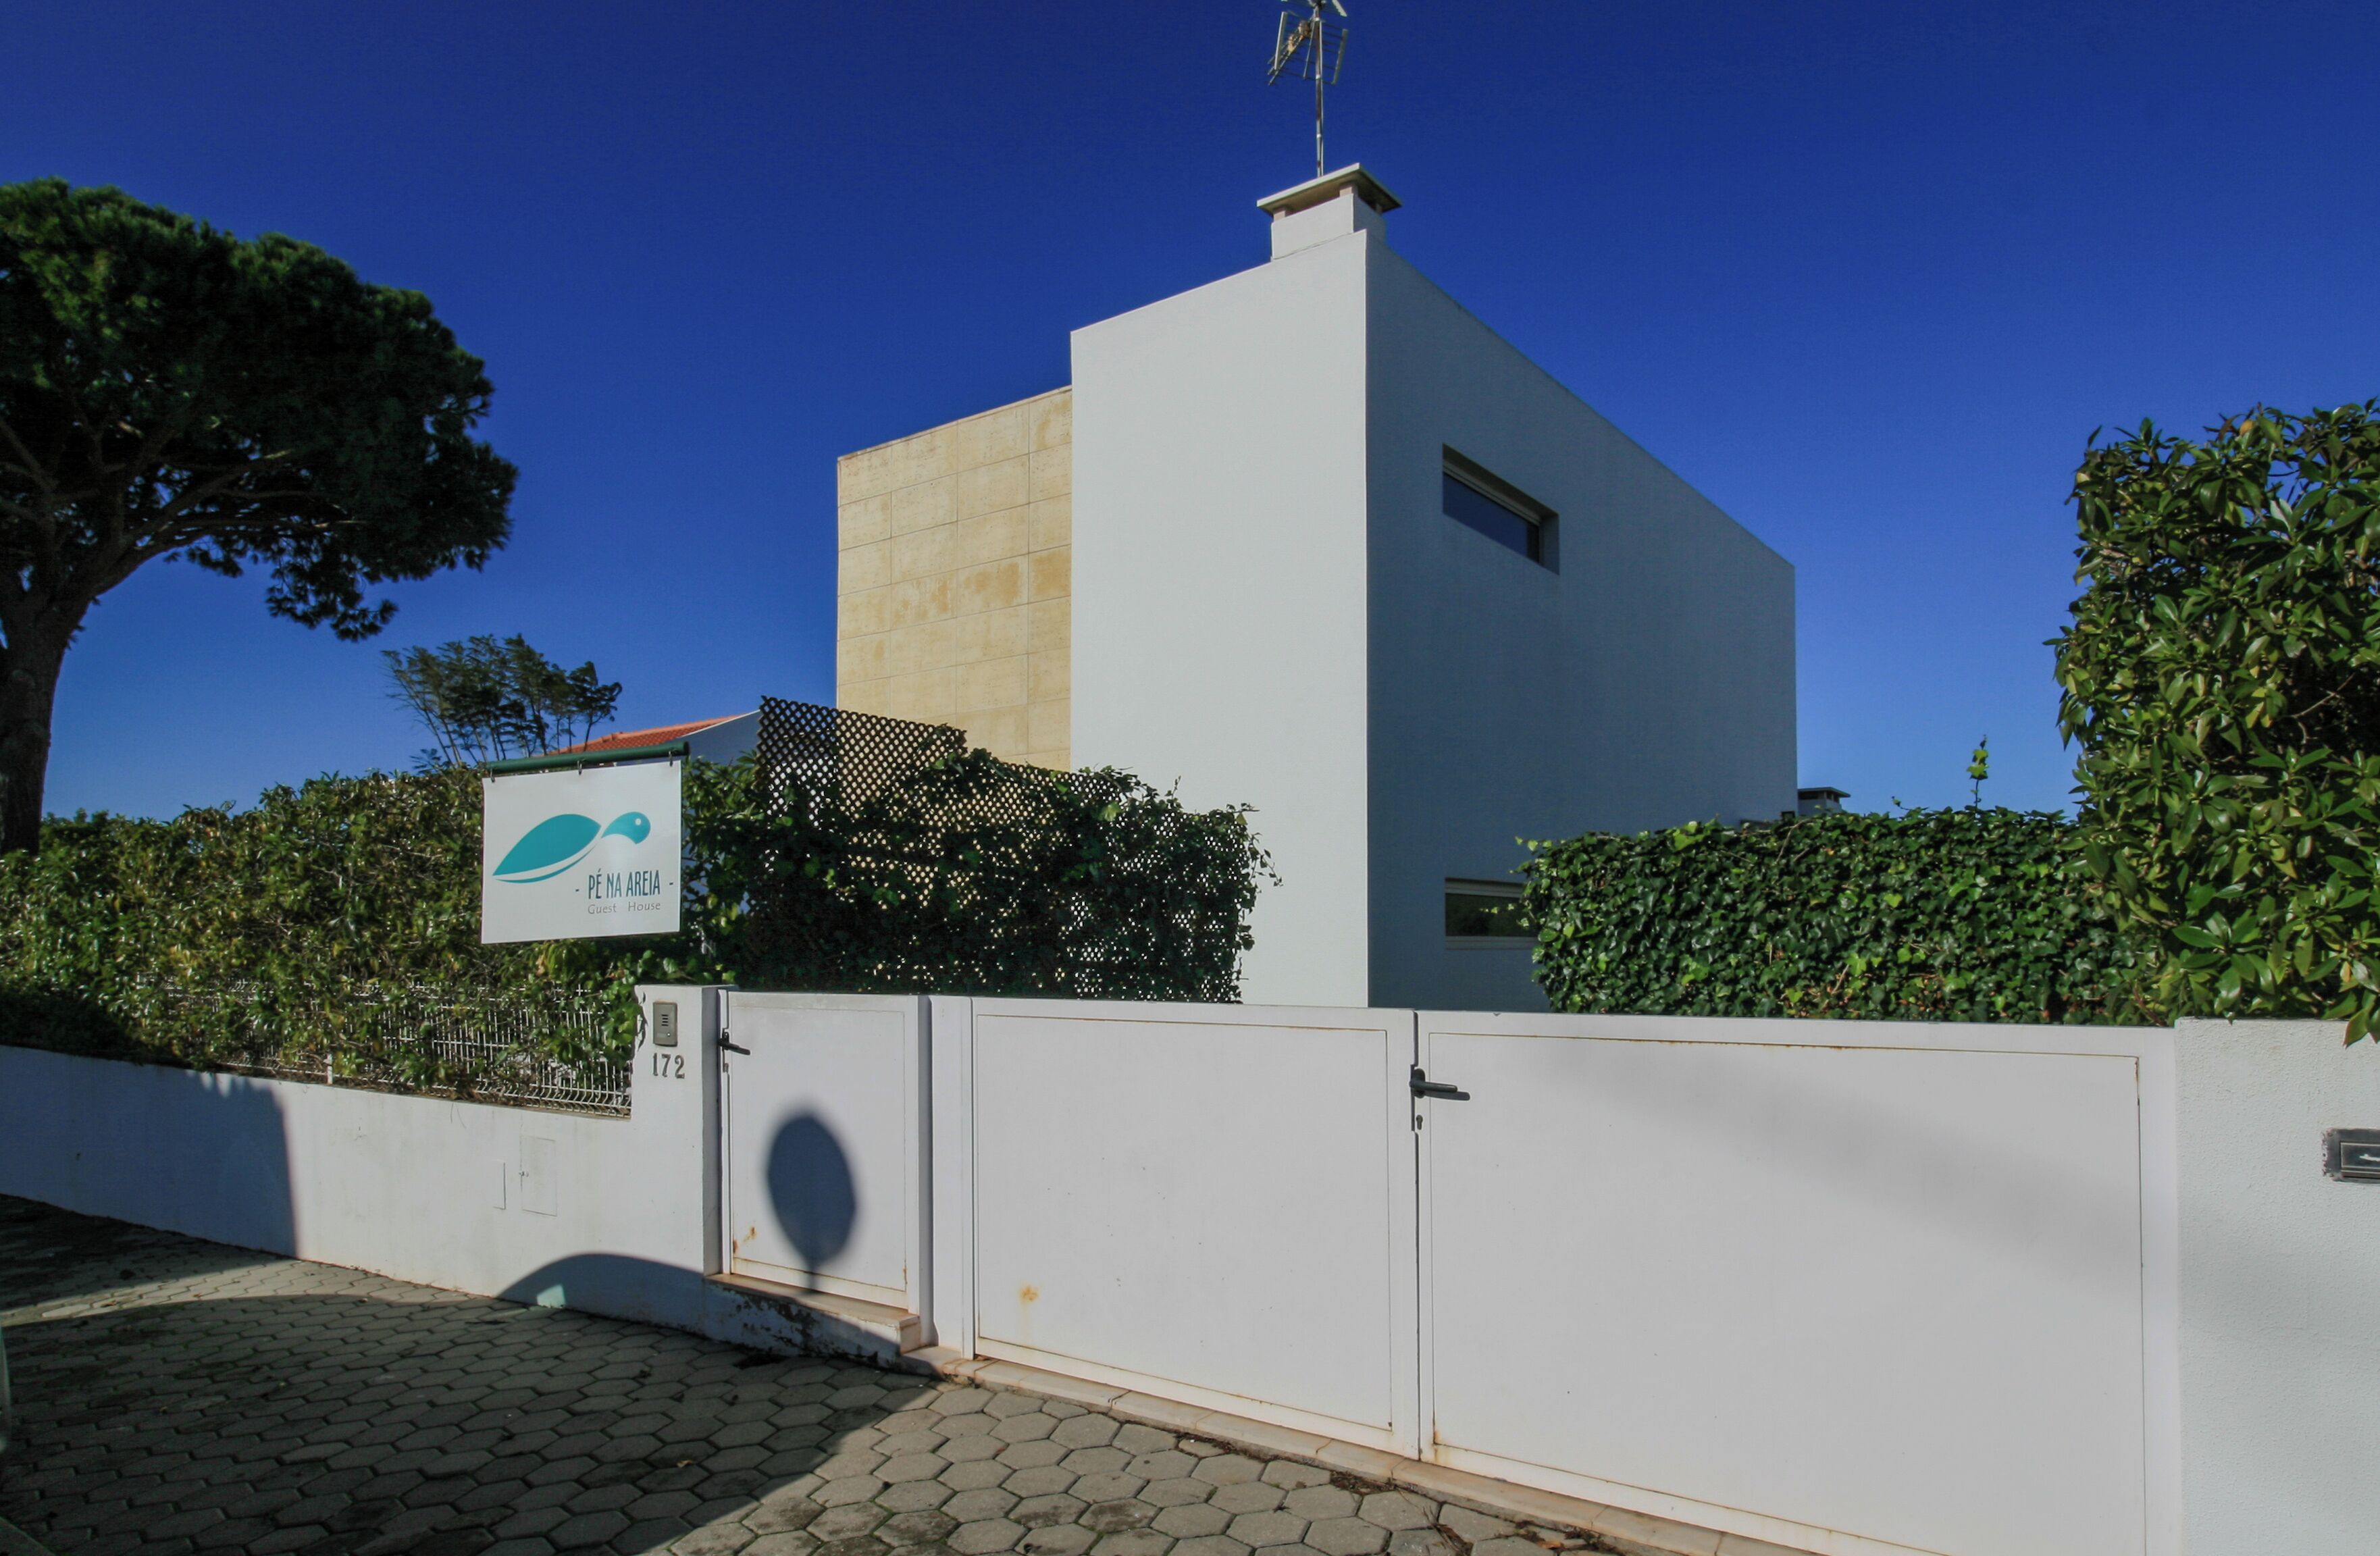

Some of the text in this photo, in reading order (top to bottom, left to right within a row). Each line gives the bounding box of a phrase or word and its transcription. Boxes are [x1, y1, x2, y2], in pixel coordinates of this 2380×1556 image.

[588, 868, 661, 899] PÉ NA AREIA
[588, 902, 661, 914] Guest House
[652, 1052, 685, 1079] 172
